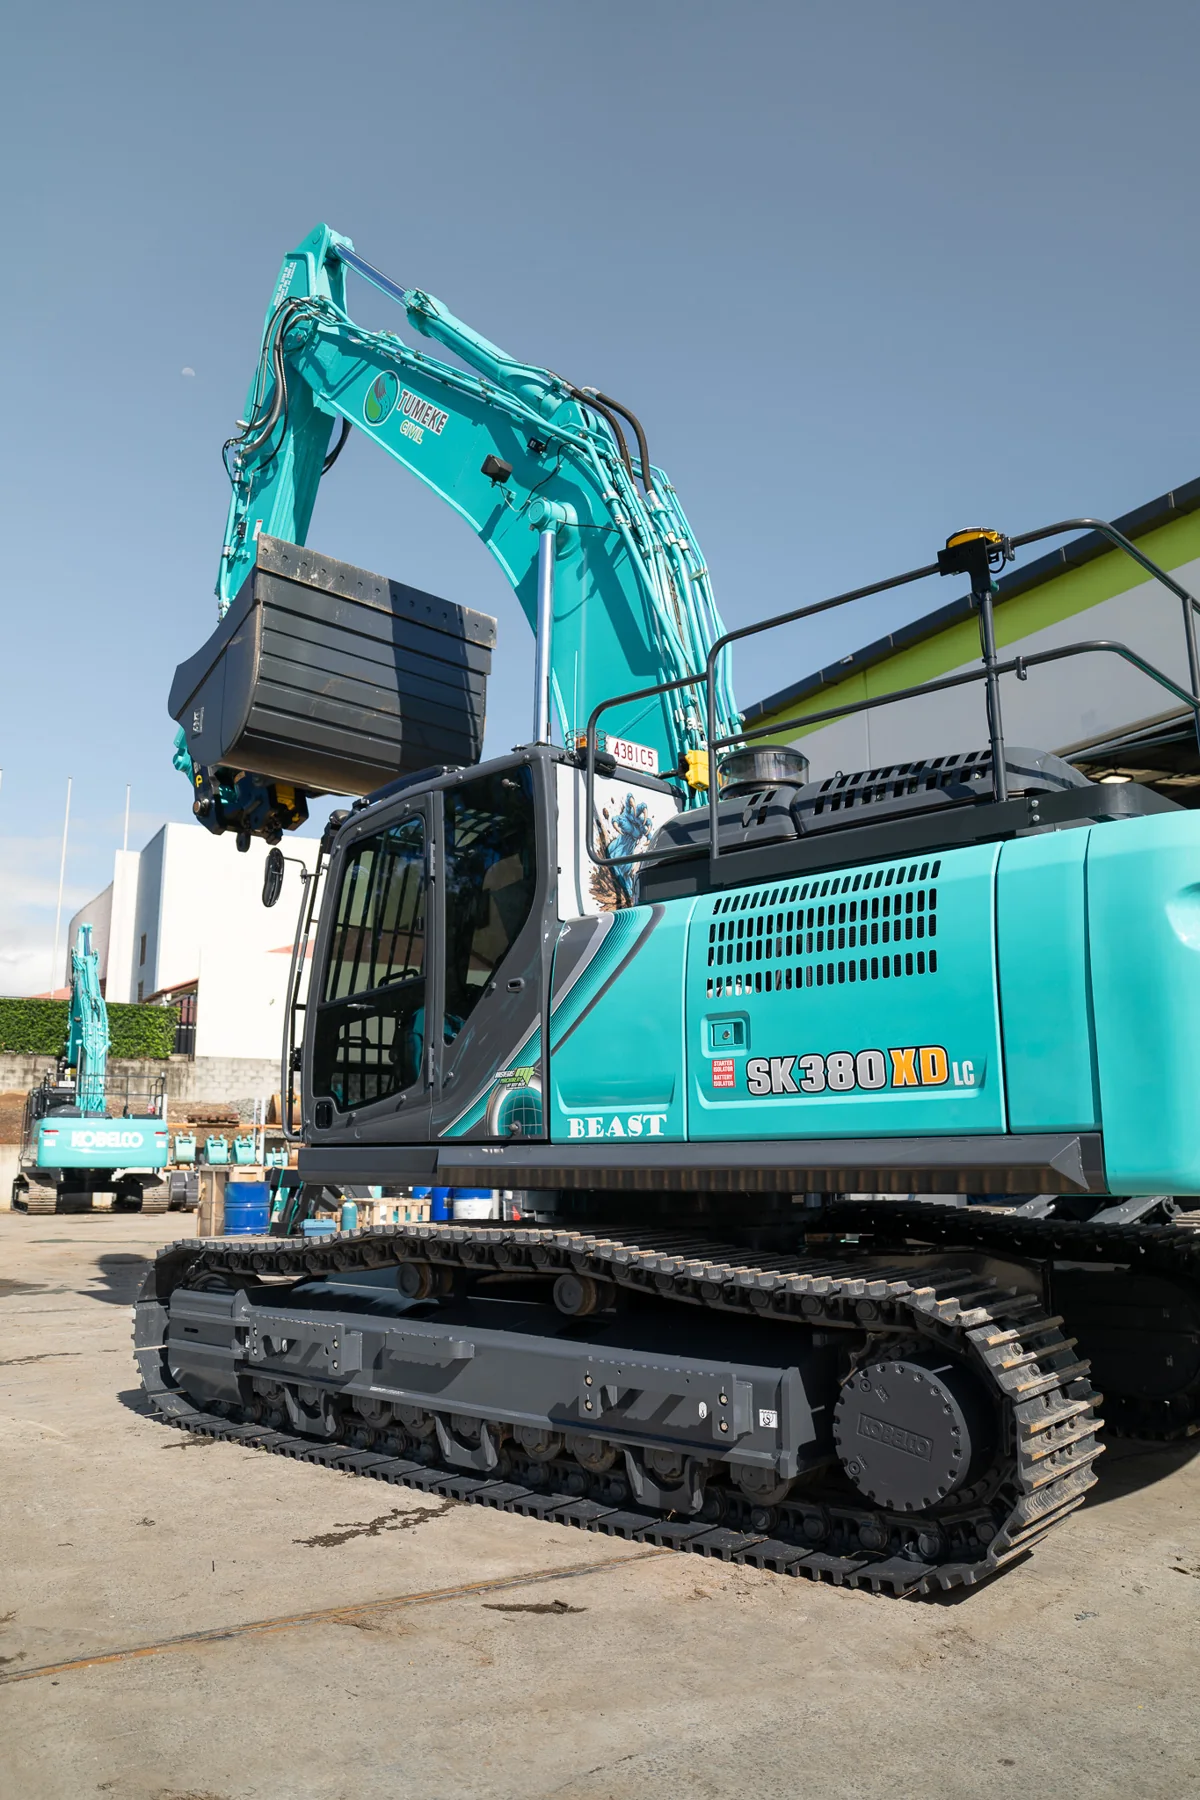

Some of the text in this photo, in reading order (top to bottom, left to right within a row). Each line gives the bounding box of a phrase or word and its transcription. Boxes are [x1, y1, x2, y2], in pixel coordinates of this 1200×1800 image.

[397, 389, 449, 436] TUMEKE
[400, 419, 424, 444] CIVIL
[952, 1060, 975, 1086] LC
[567, 1114, 667, 1138] BEAST
[71, 1131, 144, 1148] KOBELCO
[860, 1414, 931, 1460] KOBELCO
